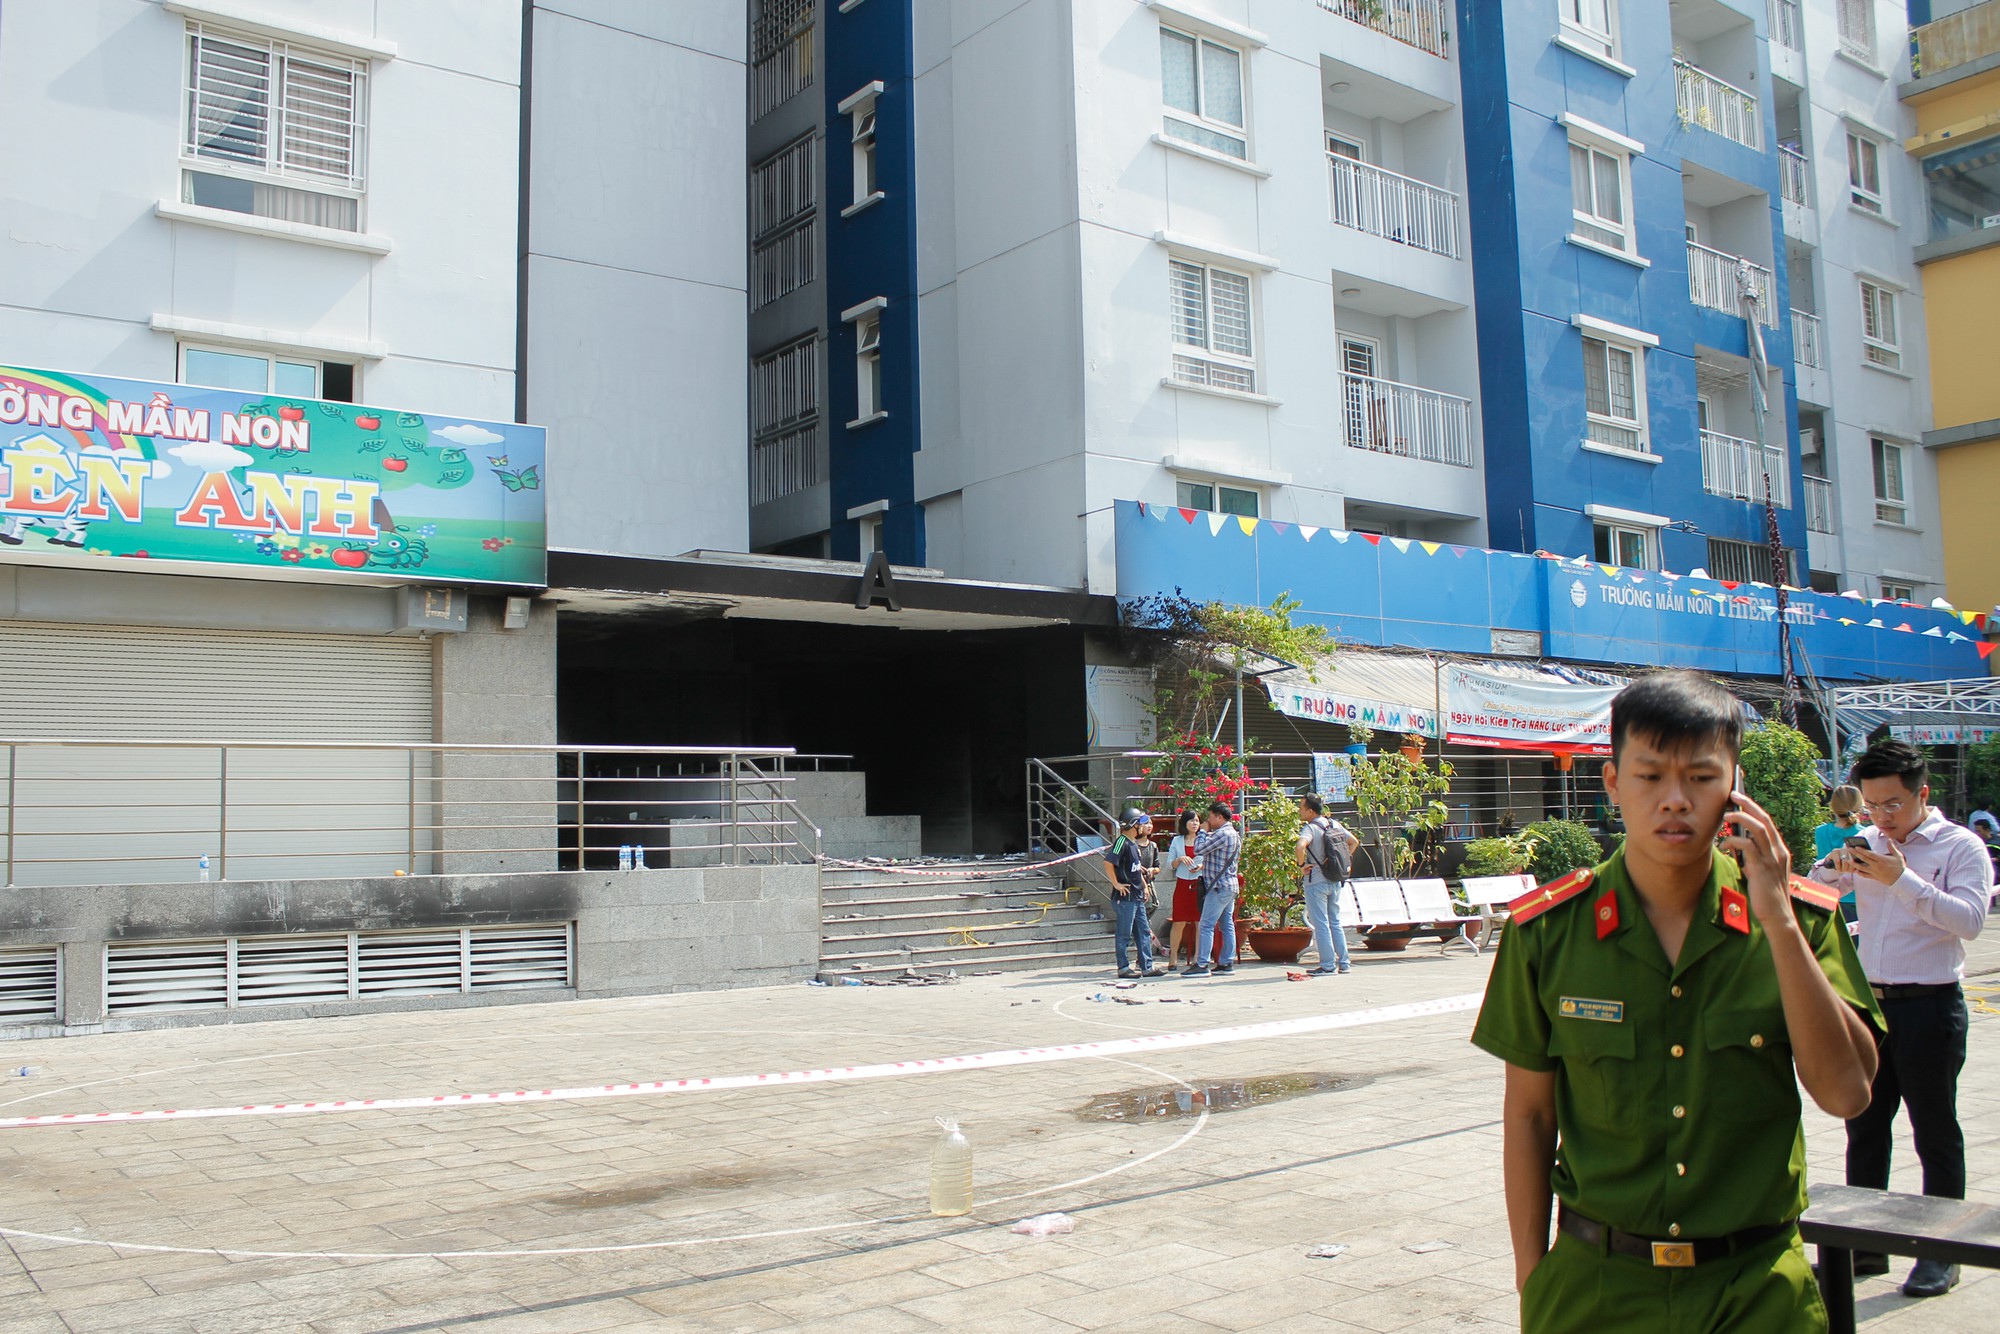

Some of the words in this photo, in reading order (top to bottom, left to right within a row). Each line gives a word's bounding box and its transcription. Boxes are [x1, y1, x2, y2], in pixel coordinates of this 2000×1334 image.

[108, 391, 210, 442] MẦM
[222, 411, 310, 453] NON
[174, 470, 381, 541] ANH
[855, 551, 902, 611] A
[1599, 583, 1652, 609] TRƯỜNG
[1655, 587, 1684, 612] MẦM
[1687, 597, 1713, 615] NON
[1293, 695, 1356, 720] TRƯỜNG
[1362, 703, 1401, 727] MẦM
[1407, 713, 1435, 733] NON
[1451, 711, 1472, 724] Ngày
[1512, 718, 1527, 729] Tra
